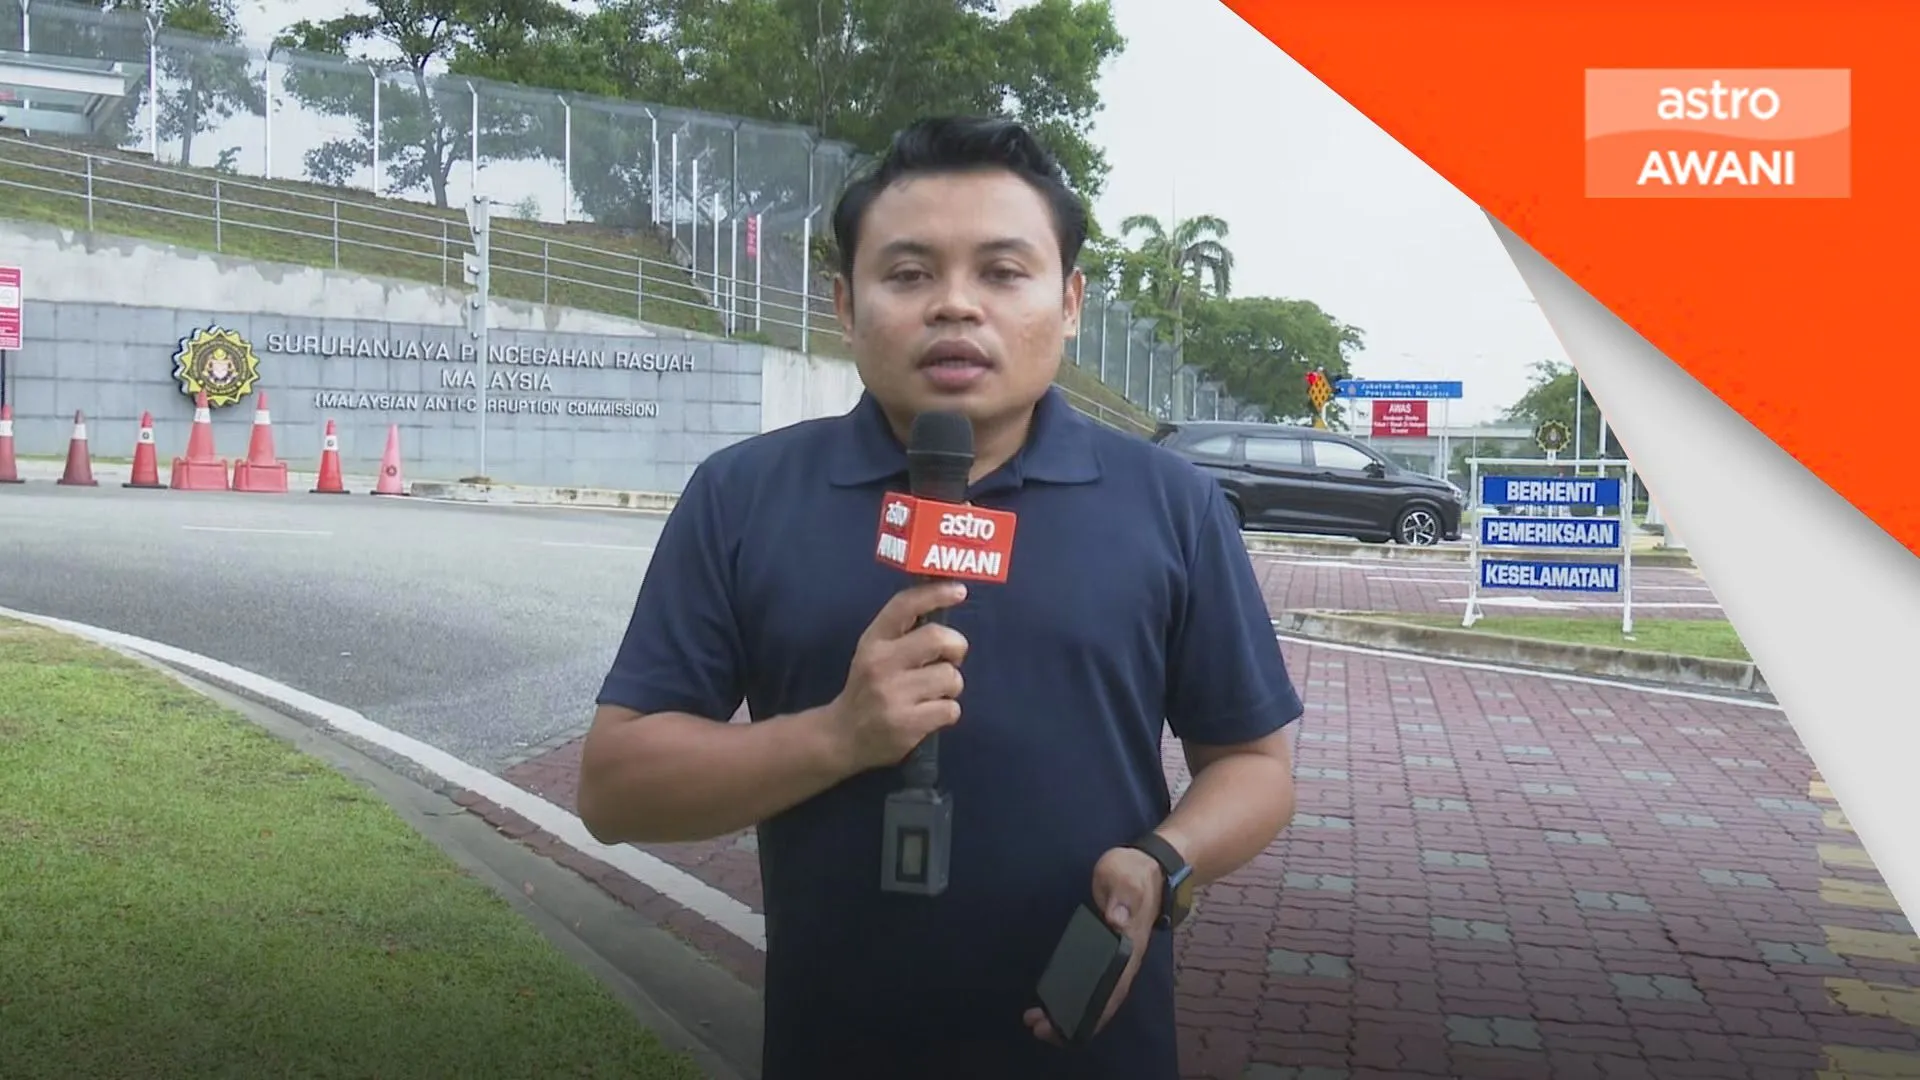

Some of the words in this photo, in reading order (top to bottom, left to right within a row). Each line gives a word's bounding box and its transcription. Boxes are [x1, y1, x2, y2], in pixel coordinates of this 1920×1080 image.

[267, 332, 450, 361] SURUHANJAYA
[460, 343, 605, 368] PNCEGAHAN
[615, 351, 696, 373] RASUAH
[441, 369, 553, 392] MAAYSIA
[314, 392, 418, 411] (MALAYSIAN
[425, 397, 561, 414] ANTI-CRRUPTION
[568, 402, 659, 417] COMMISSION)
[1389, 402, 1412, 414] AWAS
[1507, 481, 1596, 502] BERHENTI
[939, 512, 996, 540] astro
[1487, 522, 1614, 544] PEMERIKSAAN
[922, 544, 1002, 576] AWANI
[1485, 564, 1615, 588] KESELAMATAN
